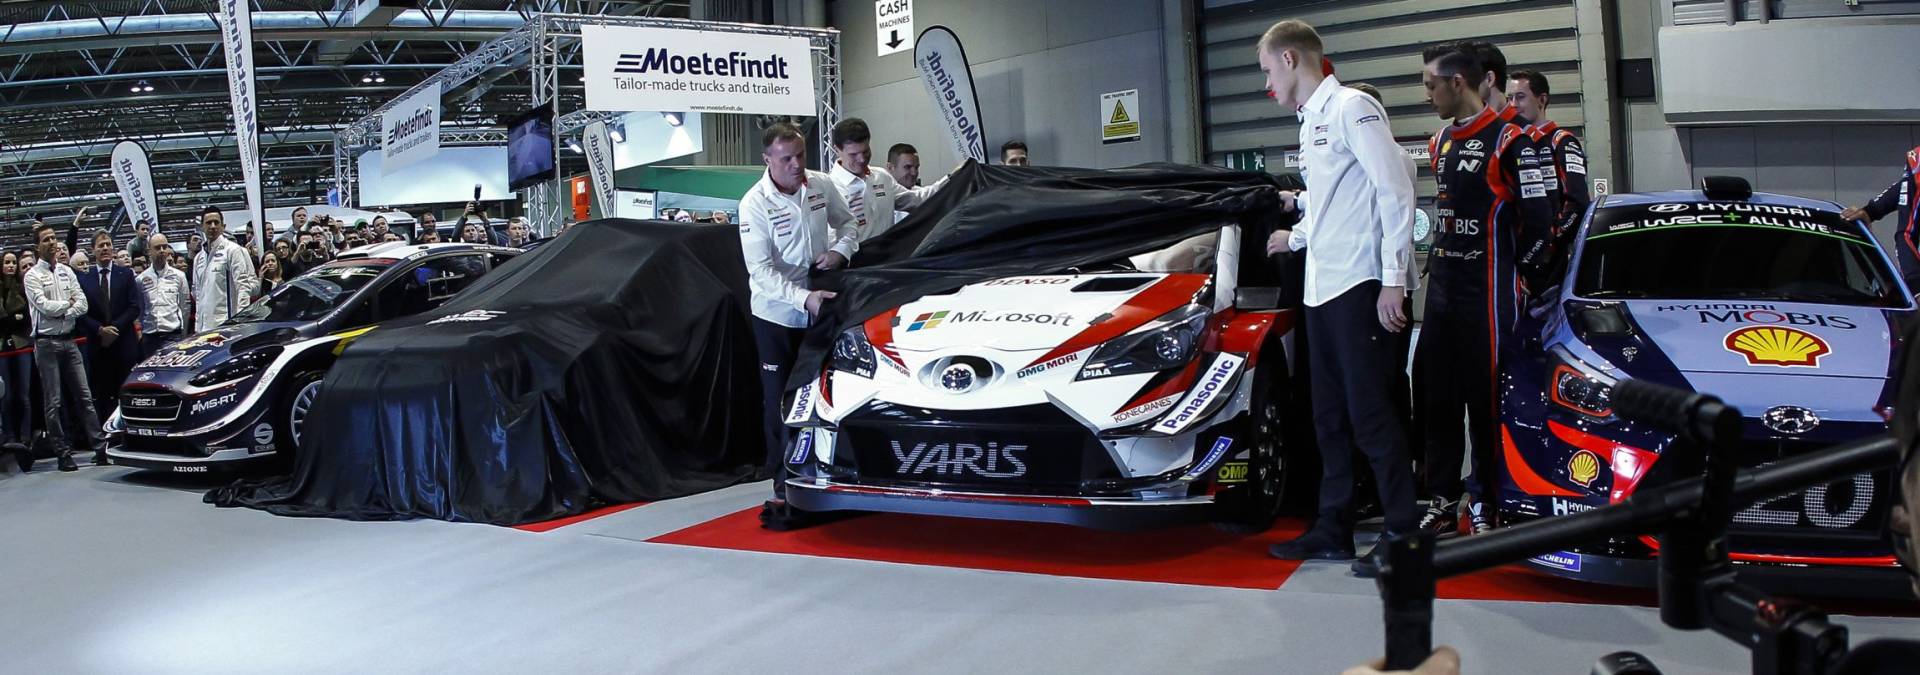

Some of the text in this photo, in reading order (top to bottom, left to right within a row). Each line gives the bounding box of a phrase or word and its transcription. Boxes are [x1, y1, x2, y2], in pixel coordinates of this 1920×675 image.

[878, 0, 909, 17] CASH
[878, 14, 911, 30] MACHINES
[640, 47, 789, 79] Moetefindt
[613, 77, 790, 95] Tailor-made trucks and trailers
[1696, 203, 1811, 217] HYUNDAI
[1749, 215, 1785, 227] ALL
[1788, 219, 1831, 234] LIVE
[985, 278, 1070, 286] DENSO
[1657, 303, 1776, 311] HYUNDAI
[1699, 310, 1857, 329] MOBIS
[1016, 353, 1079, 379] DMG MORI
[1083, 368, 1112, 378] PIAA
[1163, 359, 1235, 429] Panasonic
[1114, 398, 1173, 424] KONECRANES
[172, 465, 208, 473] AZIONE
